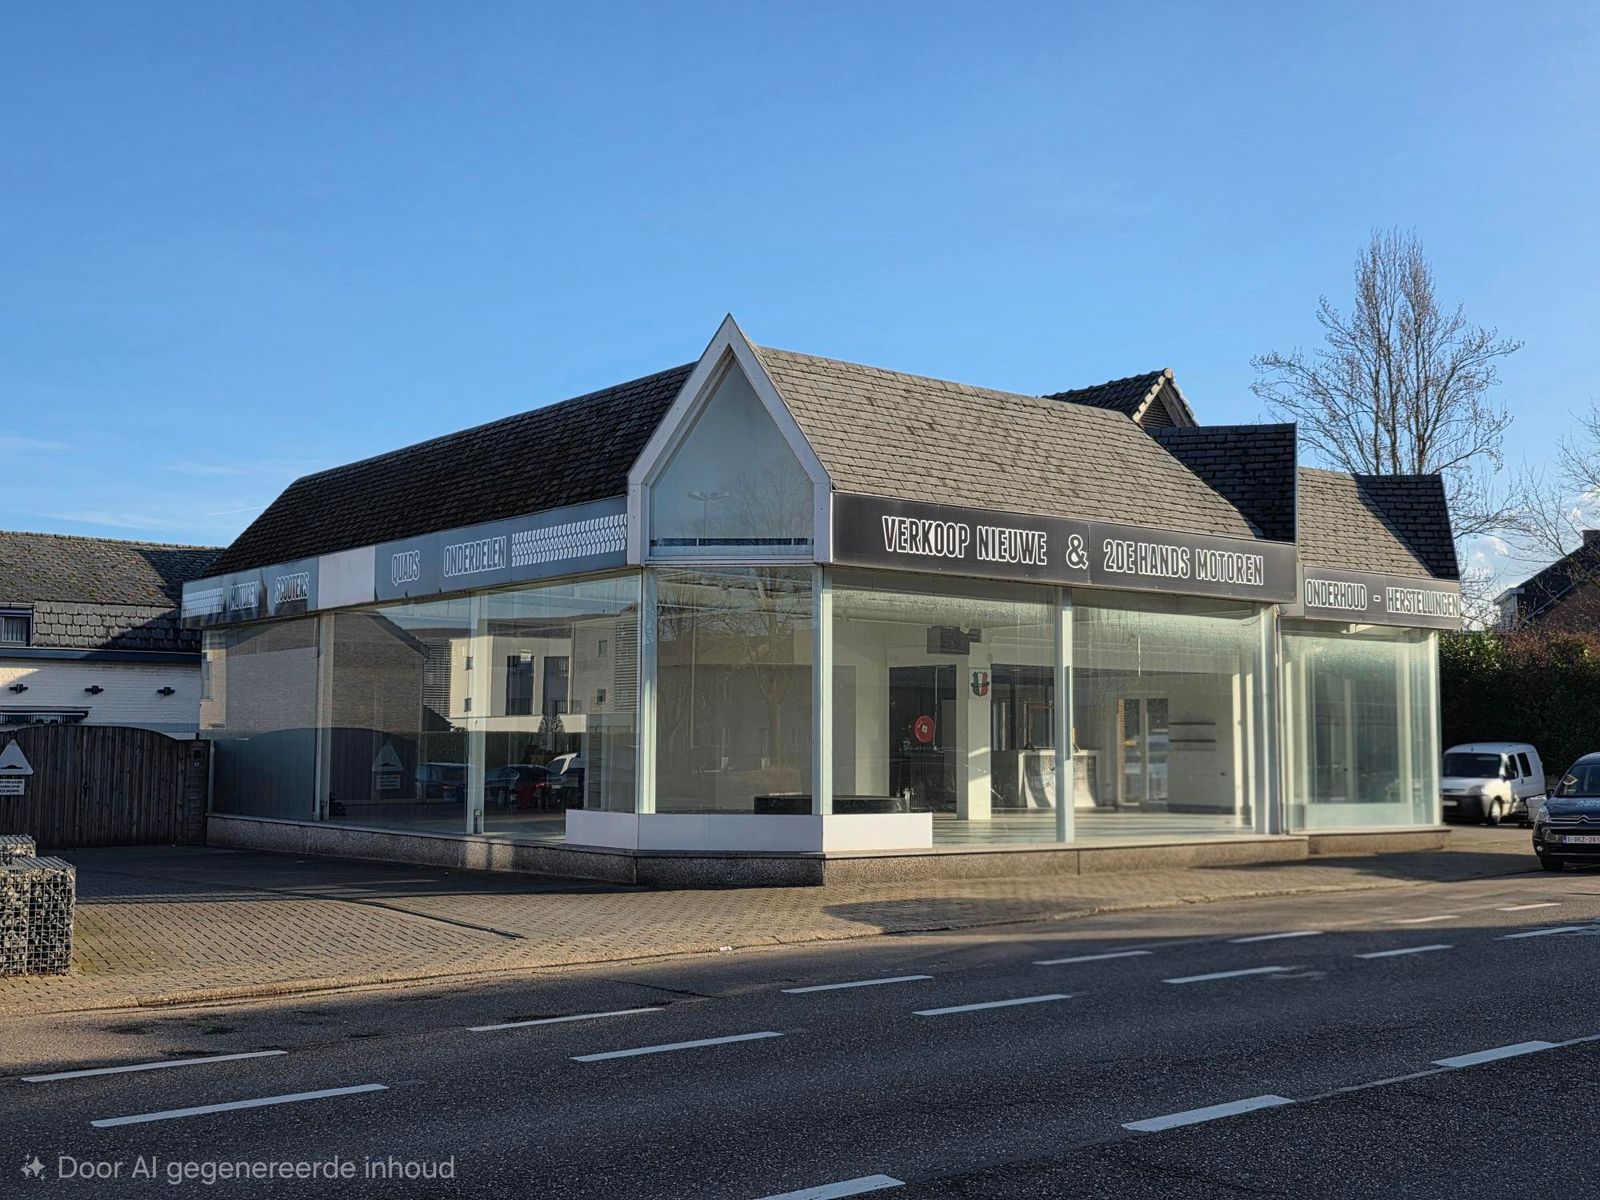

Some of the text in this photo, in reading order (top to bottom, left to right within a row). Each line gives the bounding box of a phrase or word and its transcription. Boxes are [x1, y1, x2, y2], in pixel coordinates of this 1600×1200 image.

[392, 550, 420, 586] QUADS
[444, 536, 507, 577] ONDERDELEN
[882, 516, 1264, 586] VERKOOP NIEUWE & 2DE HANDS MOTOREN
[275, 572, 310, 603] SCOOTERS
[1305, 579, 1367, 610] ONDERHOUD
[1386, 587, 1460, 618] HERSTELLINGEN
